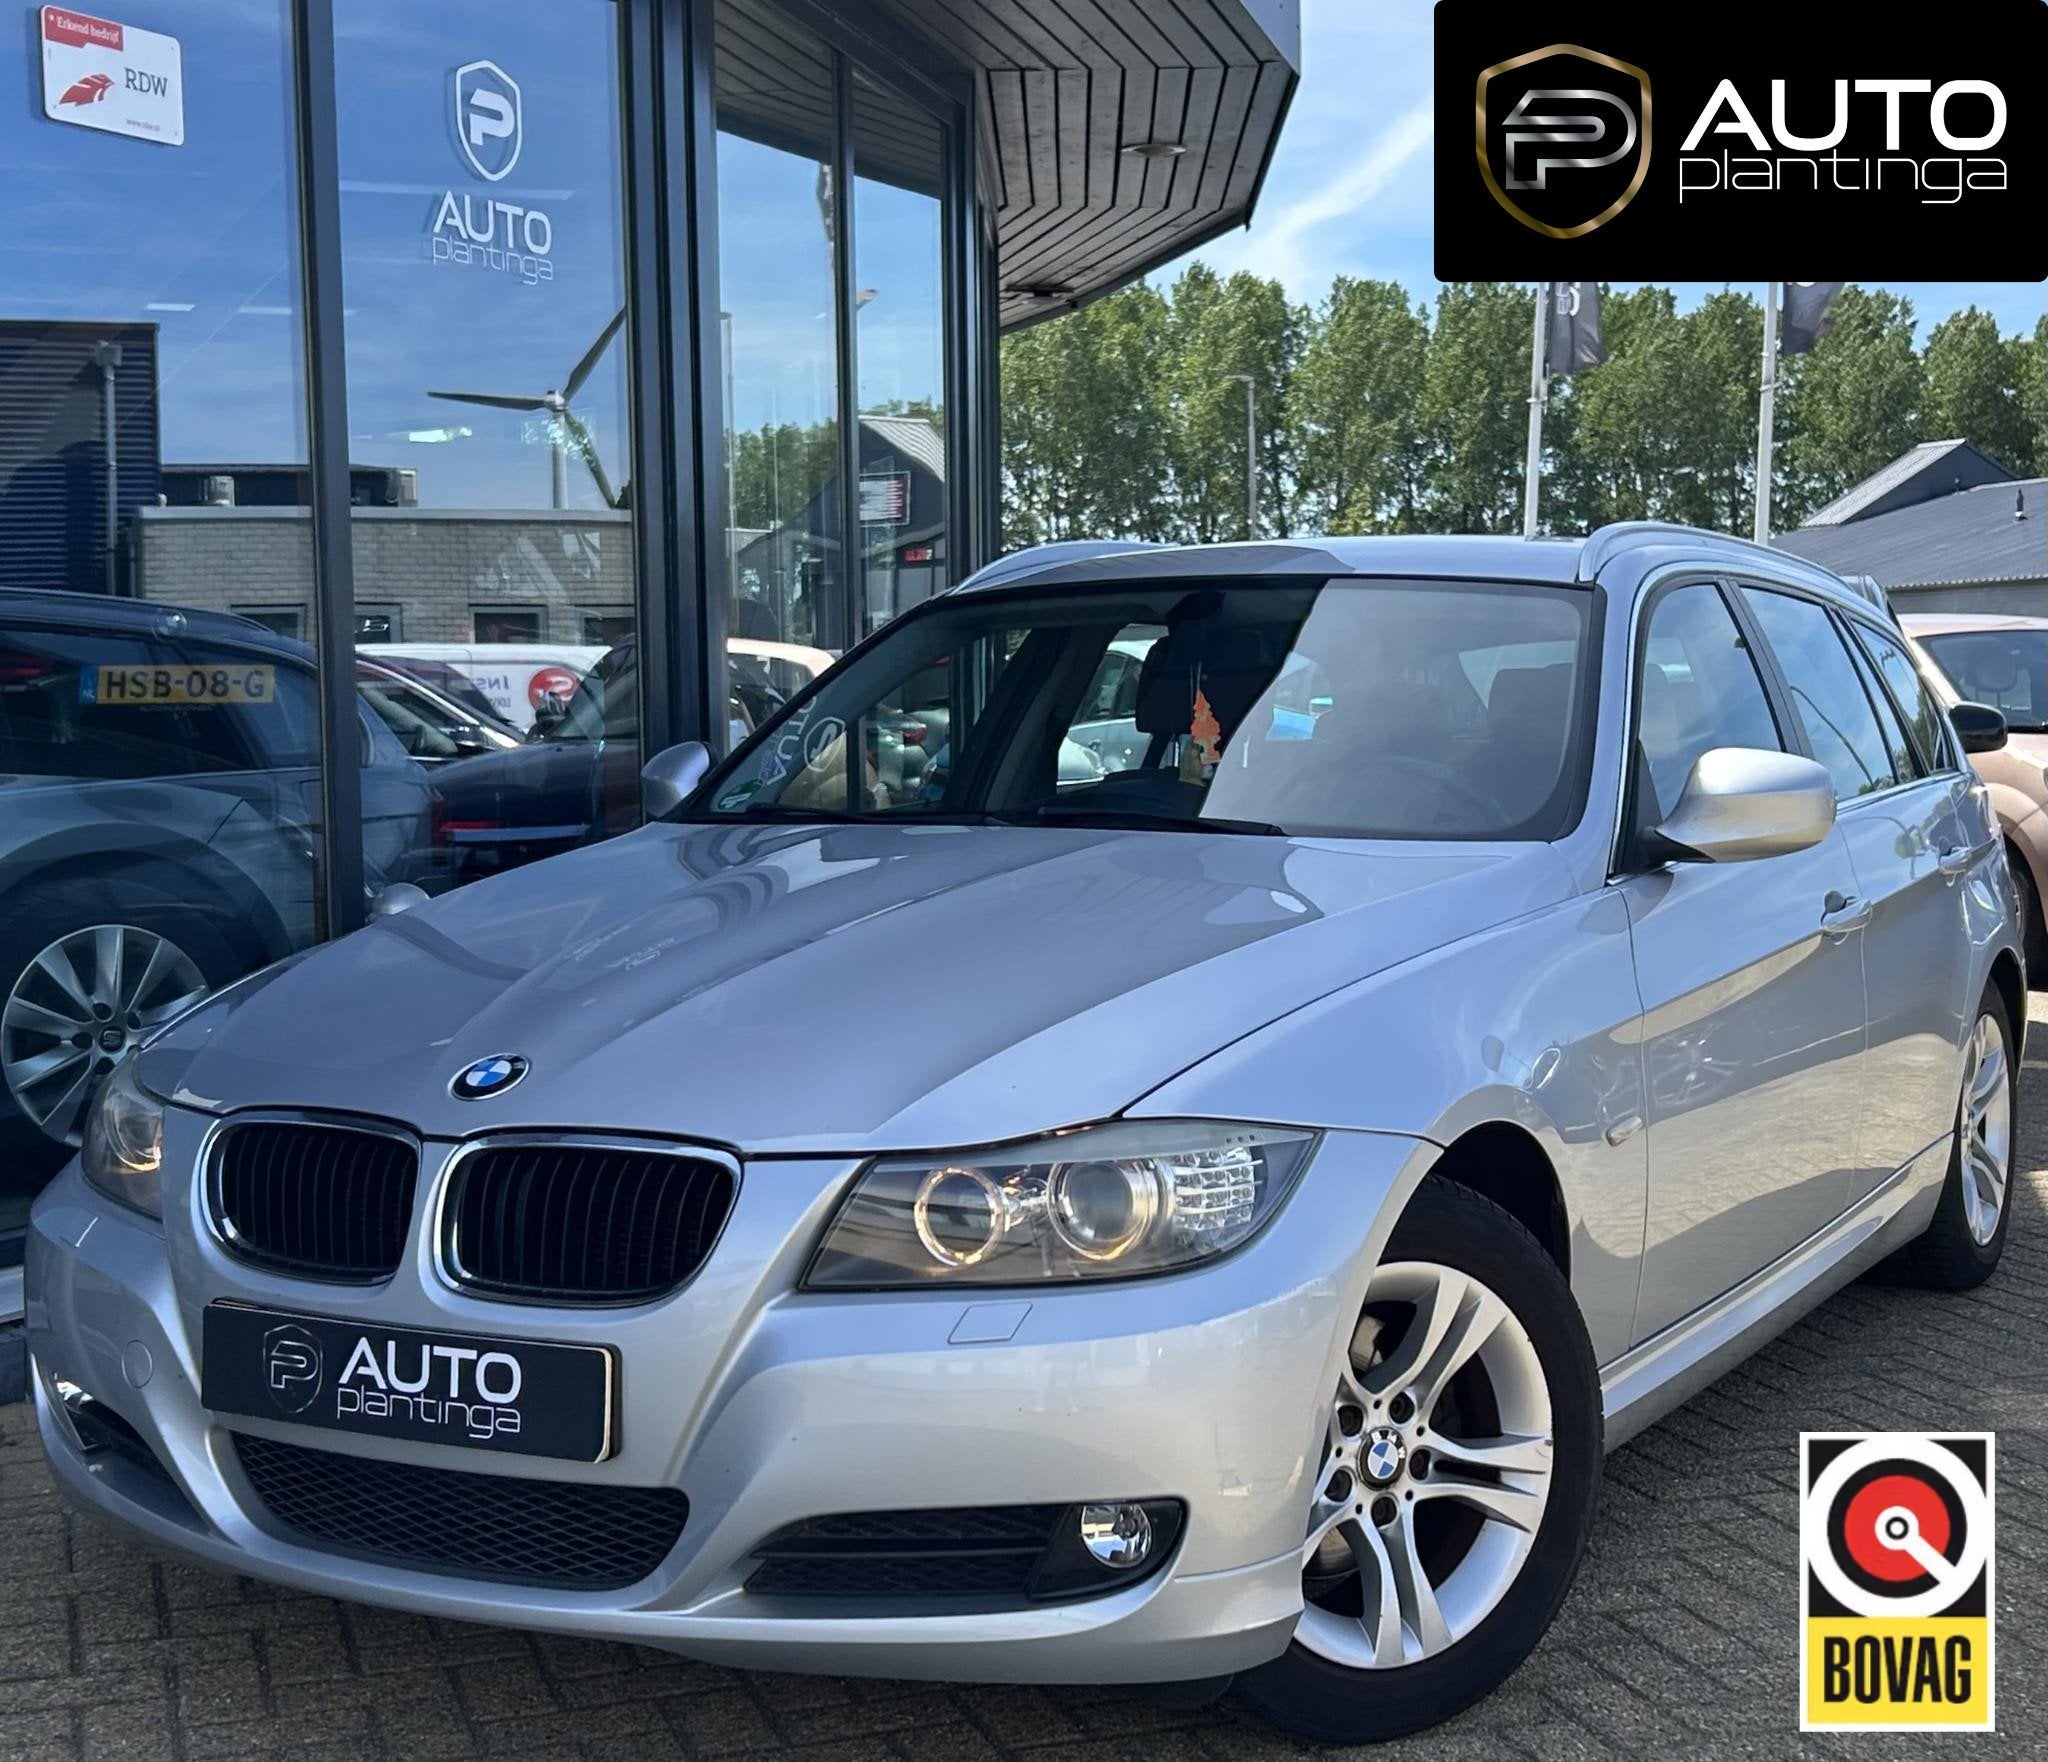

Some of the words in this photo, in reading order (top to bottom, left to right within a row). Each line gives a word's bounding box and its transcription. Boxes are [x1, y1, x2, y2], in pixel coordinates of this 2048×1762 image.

[124, 67, 168, 97] RDW
[433, 190, 552, 255] AUTO
[432, 236, 554, 285] plantinga
[106, 669, 265, 698] HSB-08-G
[338, 1336, 522, 1404] AUTO
[336, 1384, 521, 1440] plantinga
